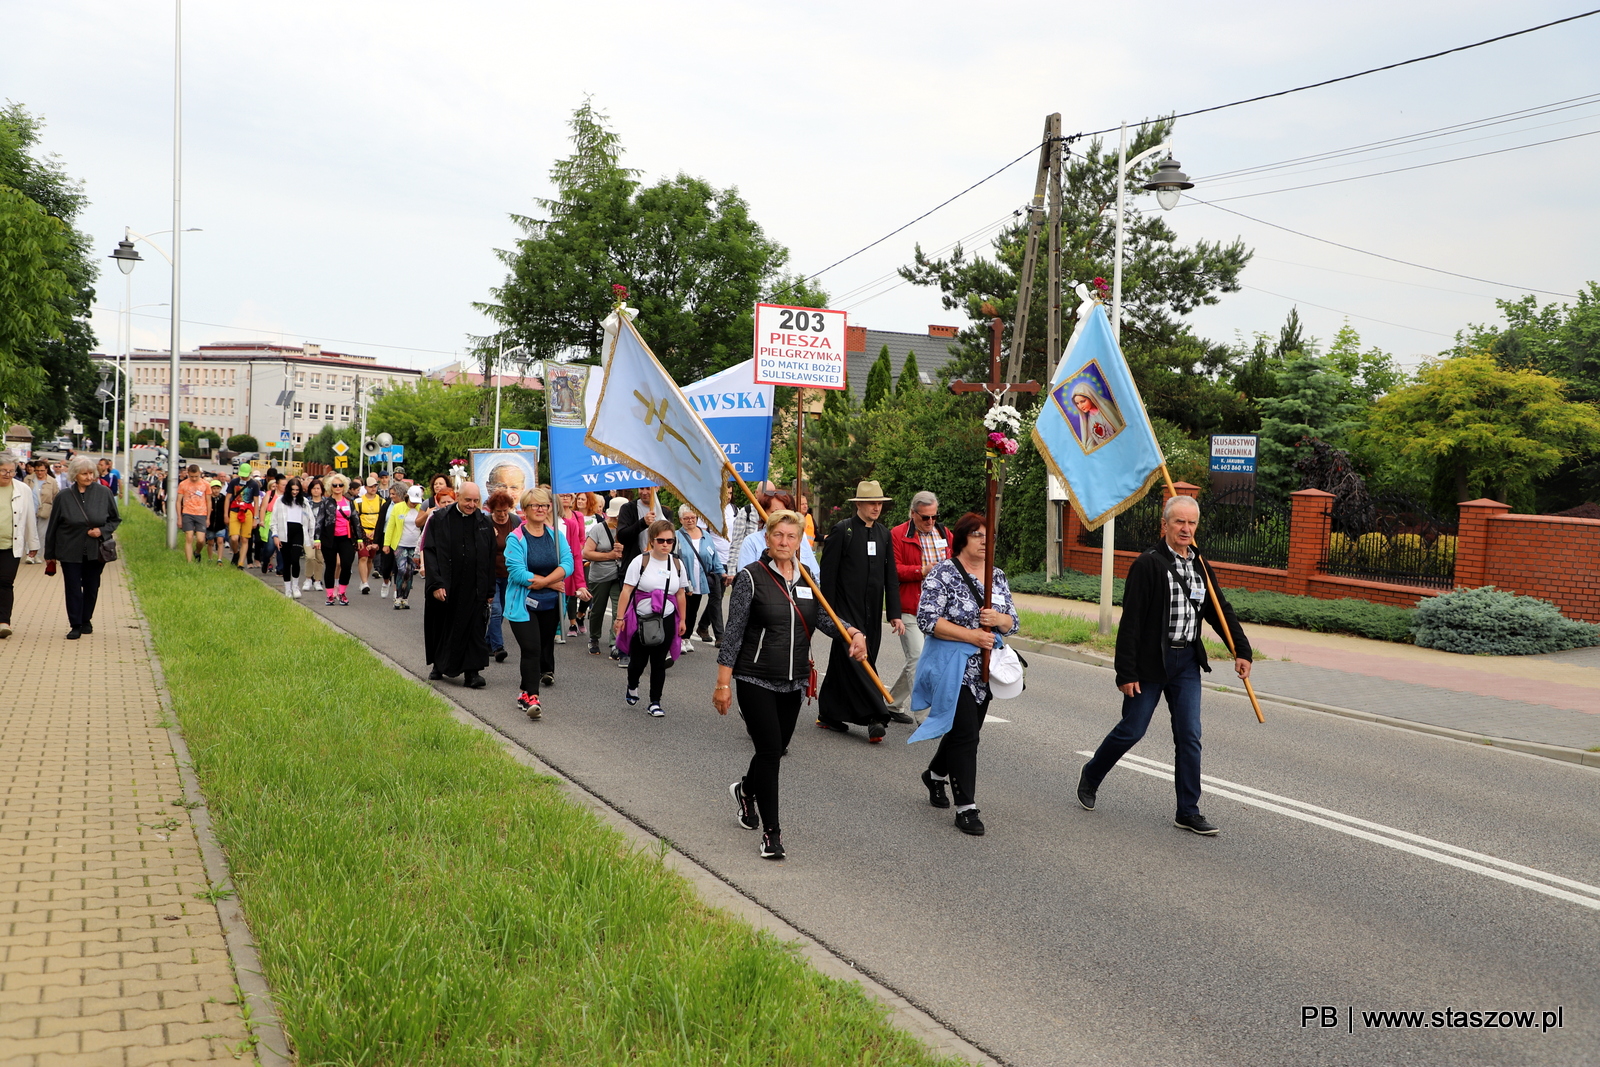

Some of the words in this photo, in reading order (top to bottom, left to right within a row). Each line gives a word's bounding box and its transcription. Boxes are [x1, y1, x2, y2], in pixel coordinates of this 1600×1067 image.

[779, 310, 825, 332] 203
[770, 333, 832, 349] PIESZA
[760, 347, 842, 362] PIELGRZYMKA
[778, 361, 808, 370] MATKI
[812, 363, 840, 373] BOŻEJ
[762, 370, 838, 384] SULISŁAWSKIEJ
[688, 392, 766, 412] AWSKA
[1213, 438, 1256, 446] ŚLUSARSTWO
[1214, 448, 1252, 456] MECHANIKA
[582, 473, 599, 484] W
[604, 470, 651, 484] SWO
